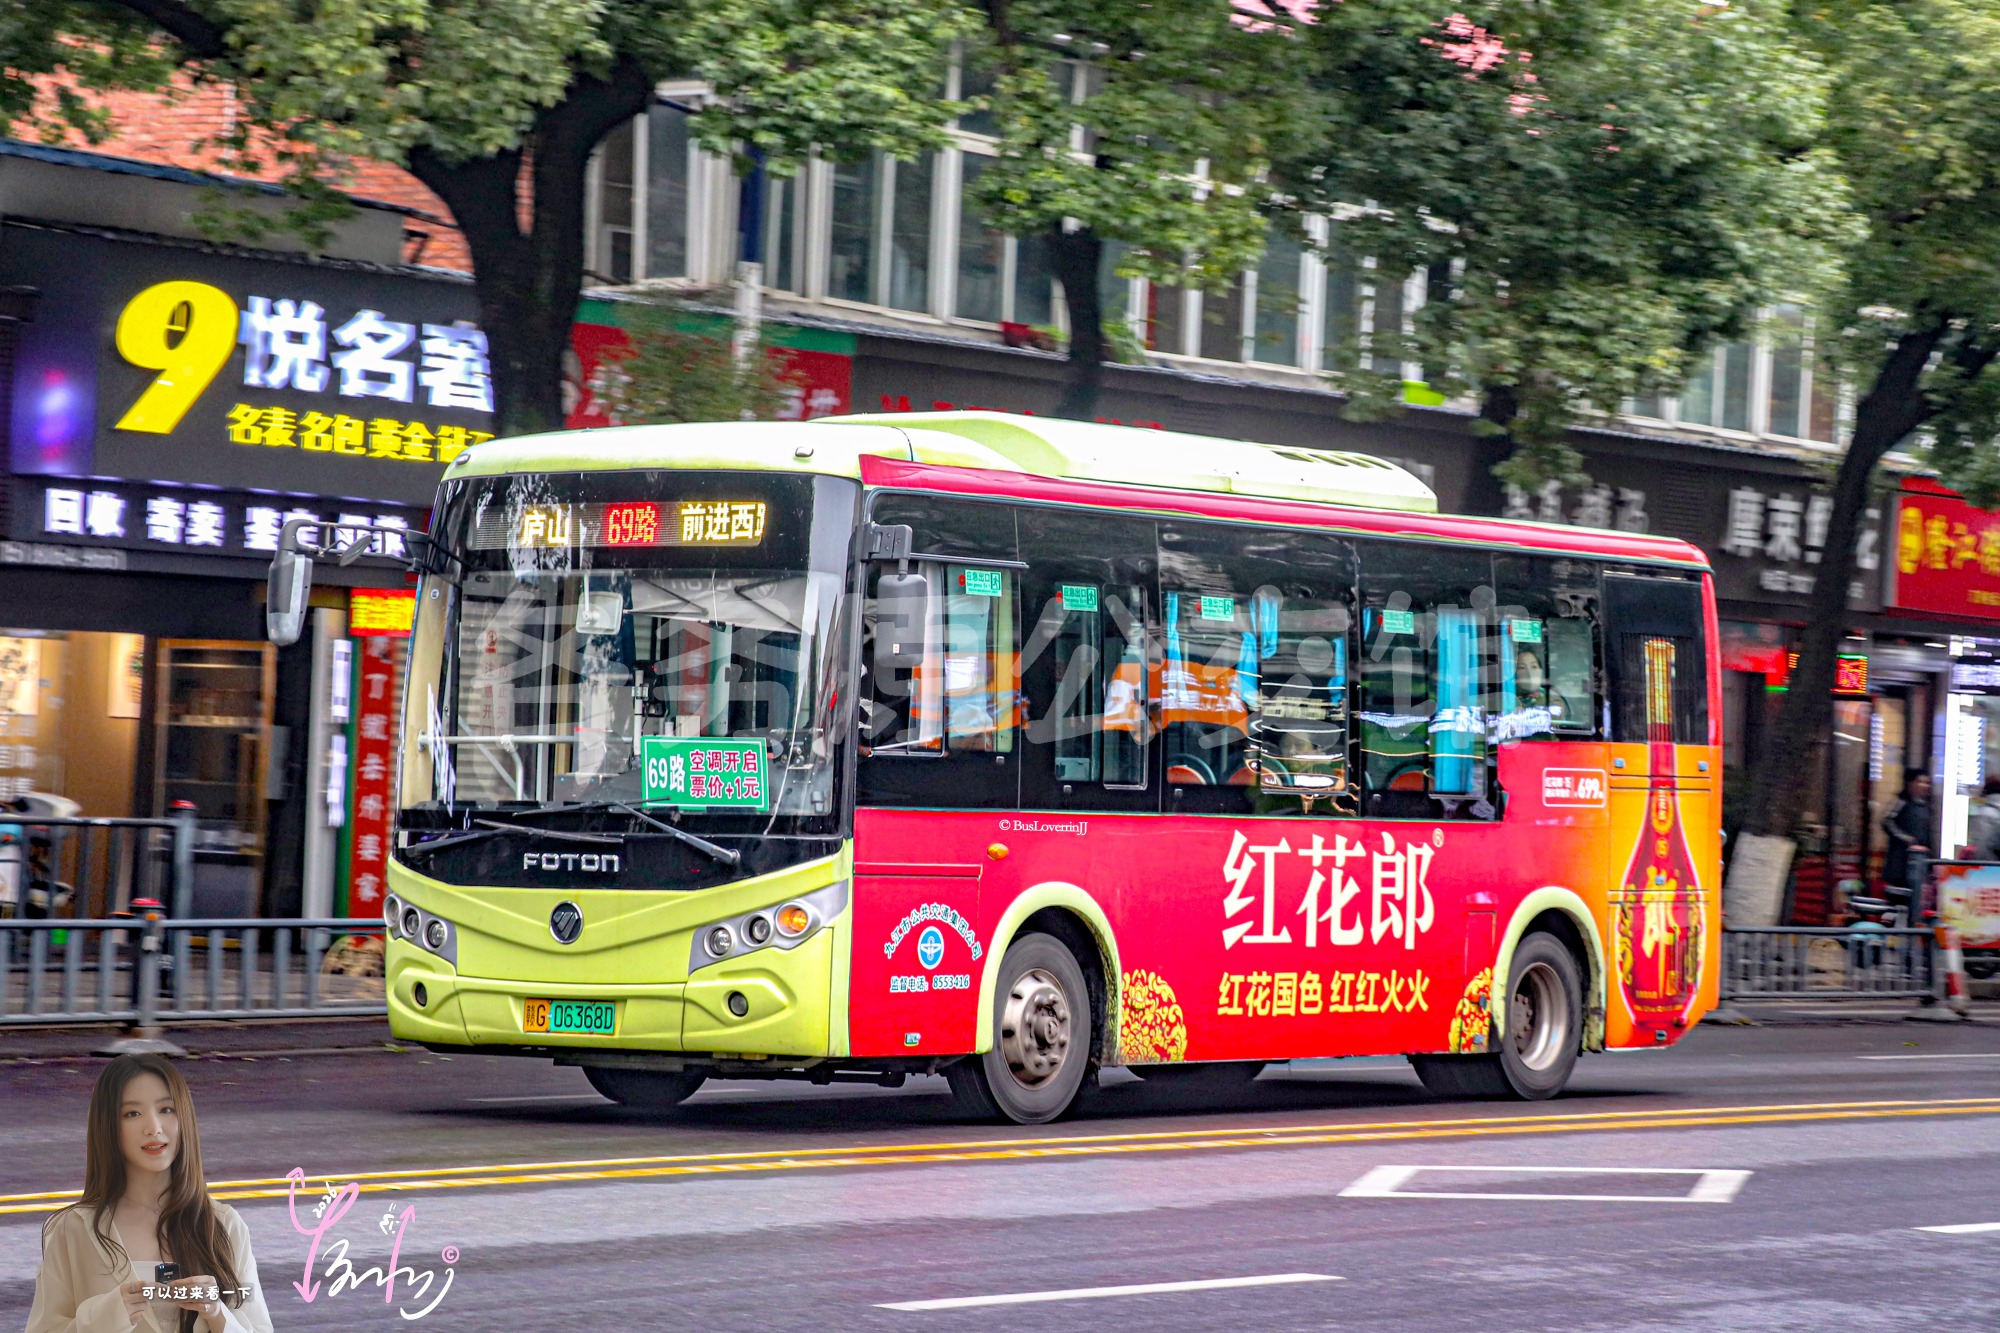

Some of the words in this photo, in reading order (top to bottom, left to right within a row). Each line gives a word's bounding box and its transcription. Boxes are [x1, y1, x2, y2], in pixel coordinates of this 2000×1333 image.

[115, 281, 239, 434] 9
[521, 508, 571, 546] 庐山
[608, 505, 657, 544] 69路
[649, 753, 686, 793] 69路
[689, 749, 758, 772] 空调开启
[689, 775, 760, 799] 票价+1元
[523, 852, 620, 873] FOTON
[1222, 829, 1435, 951] 红花郎
[884, 902, 983, 961] 九江市公共交通集团公司
[1217, 970, 1323, 1018] 红花国色
[1329, 968, 1430, 1014] 红红火火
